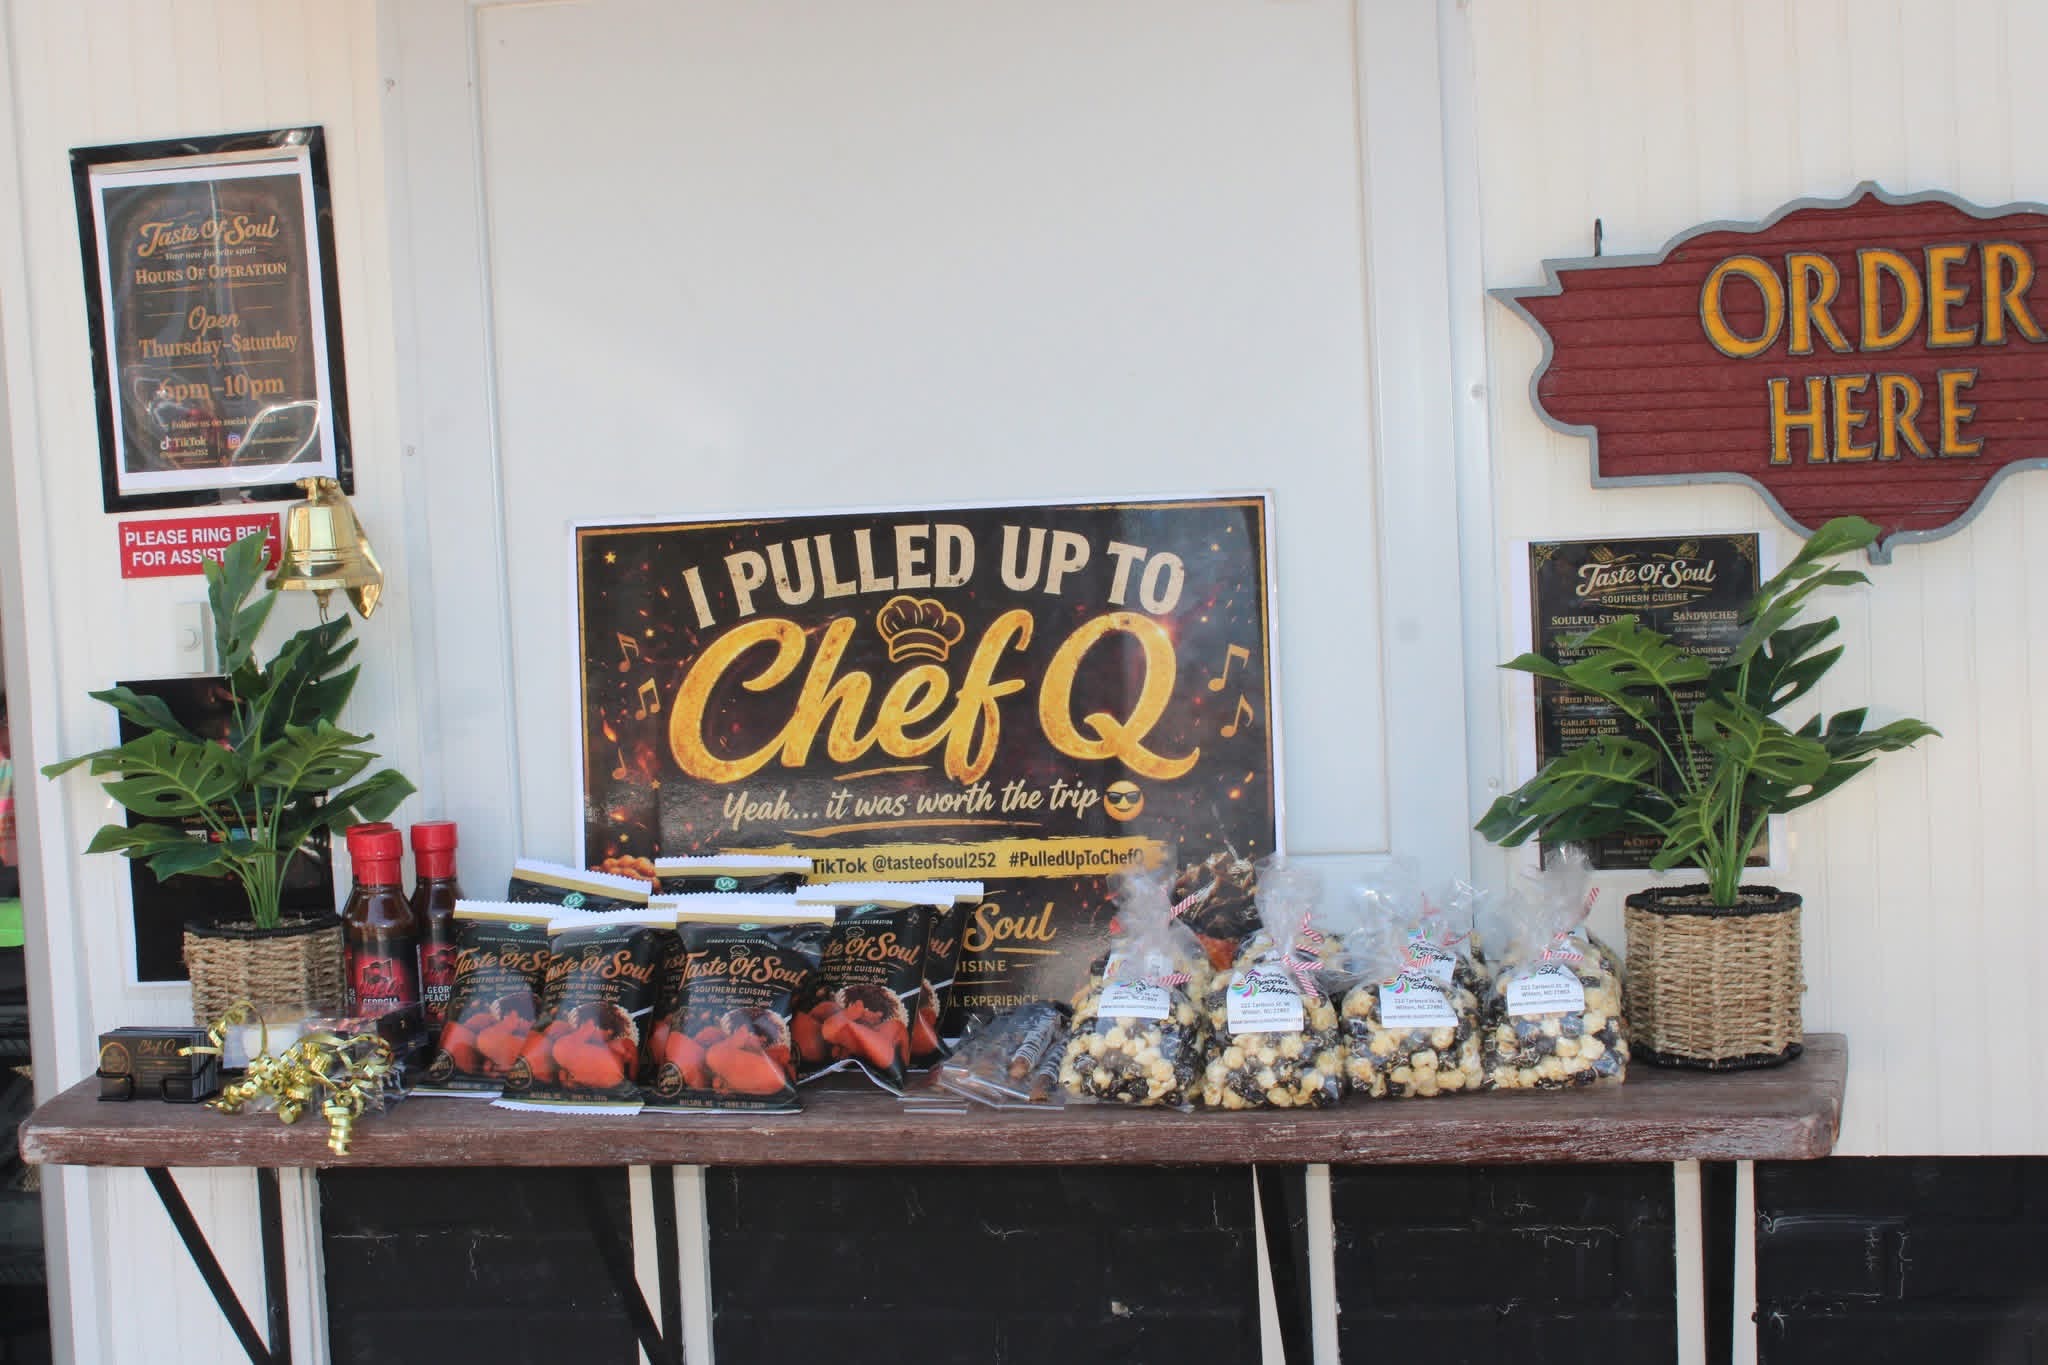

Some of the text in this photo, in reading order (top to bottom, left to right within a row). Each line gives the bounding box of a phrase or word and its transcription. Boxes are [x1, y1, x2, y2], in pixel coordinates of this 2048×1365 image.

[138, 215, 279, 257] Taste Of Soul
[135, 262, 288, 285] HOURS OF OPERATION
[1700, 238, 2048, 359] ORDER
[188, 305, 241, 336] Open
[1768, 367, 1986, 465] HERE
[125, 528, 188, 547] PLEASE
[192, 528, 231, 544] RING
[132, 550, 166, 567] FOR
[682, 523, 1187, 630] I PULLED UP TO
[1575, 559, 1717, 597] Taste Of Soul
[1601, 592, 1689, 605] SOUTHERN CUISINE
[1551, 614, 1597, 626] SOULFUL
[1672, 609, 1739, 621] SANDWICHES
[668, 607, 1200, 786] Chef Q
[1560, 718, 1590, 727] GARLIC
[722, 778, 1100, 830] Yeah... it was worth the trip
[812, 857, 867, 875] TikTok
[872, 852, 997, 873] @tasteofsoul252
[962, 901, 1057, 952] Soul
[844, 936, 875, 957] Of
[866, 931, 921, 967] Soul
[580, 954, 611, 975] Of
[601, 950, 656, 984] Soul
[679, 949, 729, 991] Taste
[728, 956, 761, 978] Of
[751, 955, 809, 985] Soul
[854, 965, 887, 975] CUISINE
[738, 986, 773, 998] CUISINE
[1246, 975, 1290, 986] Popcorn
[424, 993, 450, 1002] PEACH
[963, 994, 1039, 1007] EXPERIENCE
